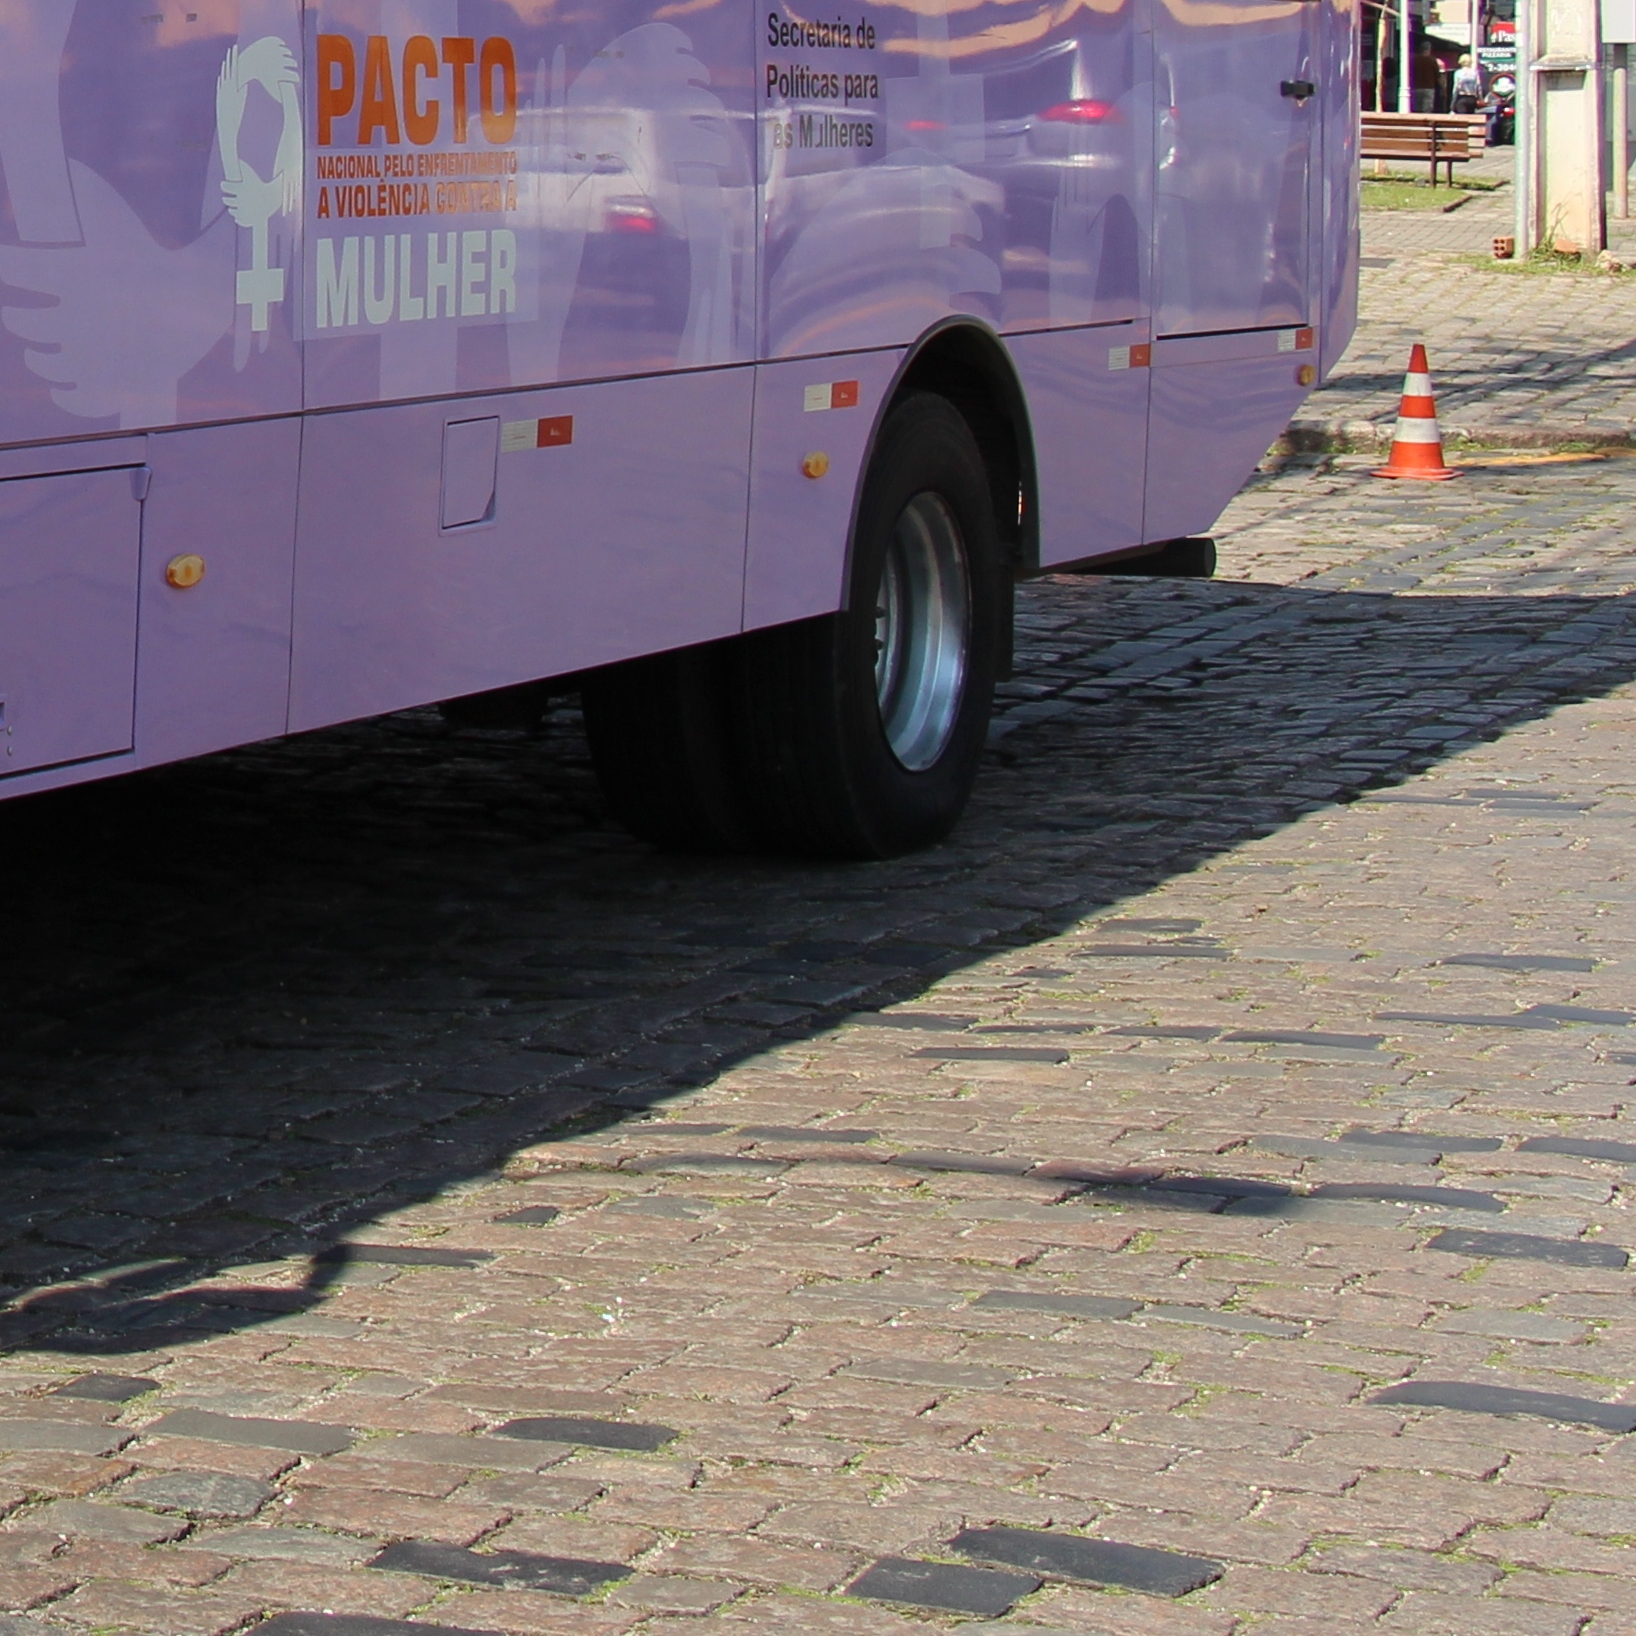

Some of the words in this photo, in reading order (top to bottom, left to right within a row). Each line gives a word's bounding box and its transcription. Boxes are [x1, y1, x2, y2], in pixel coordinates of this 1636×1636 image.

[767, 12, 852, 49] Secretaria
[856, 17, 876, 50] de
[316, 34, 517, 146] PACTO
[766, 64, 839, 99] Políticas
[844, 73, 879, 107] para
[773, 122, 793, 149] as
[799, 115, 874, 149] Mulheres
[317, 154, 381, 180] NACIONAL
[384, 153, 414, 179] PELO
[417, 150, 519, 178] ENFRENTAMENTO
[334, 178, 430, 219] VIOLÊNCIA
[435, 180, 502, 215] CONTRA
[504, 179, 518, 212] A
[316, 229, 517, 329] MULHER
